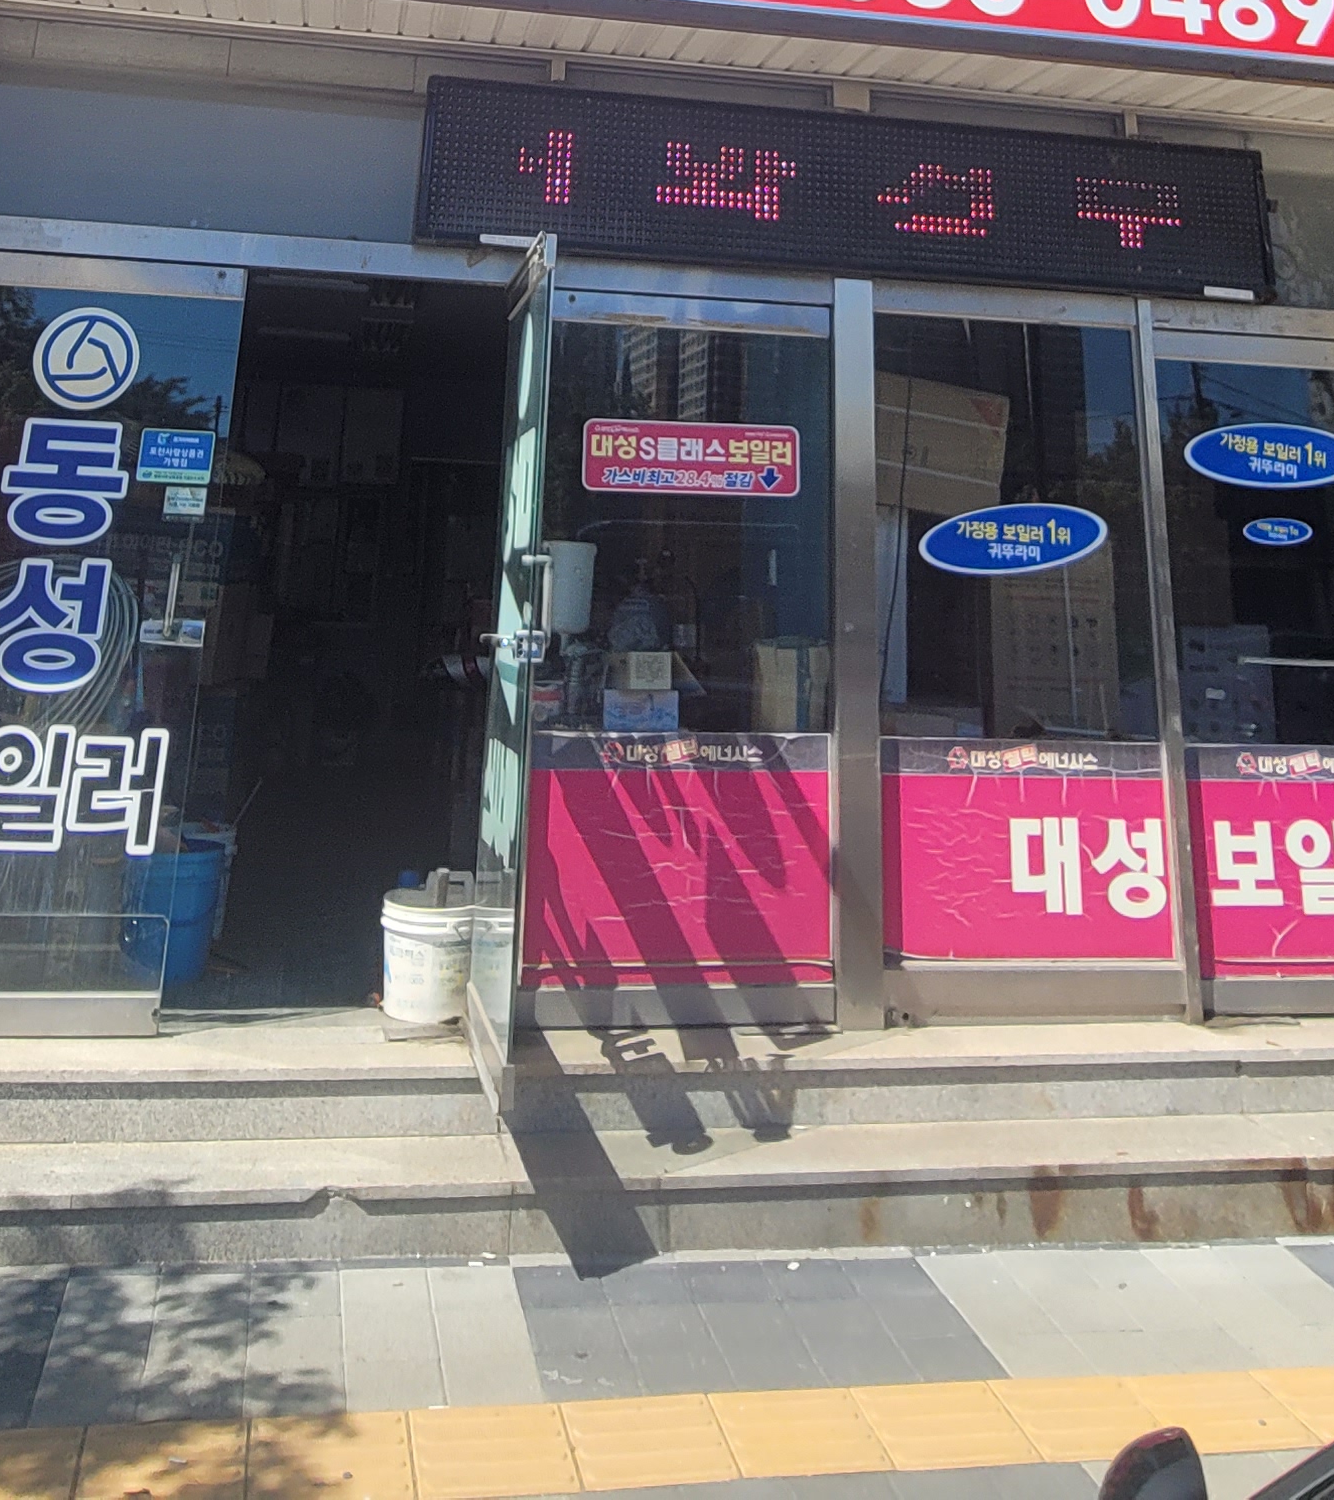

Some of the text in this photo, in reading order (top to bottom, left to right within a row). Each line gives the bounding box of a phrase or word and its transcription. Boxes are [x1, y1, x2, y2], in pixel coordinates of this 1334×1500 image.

[956, 518, 1071, 546] 가정용 보일러 1위
[986, 542, 1042, 562] 귀뚜라미
[1008, 815, 1168, 919] 대성
